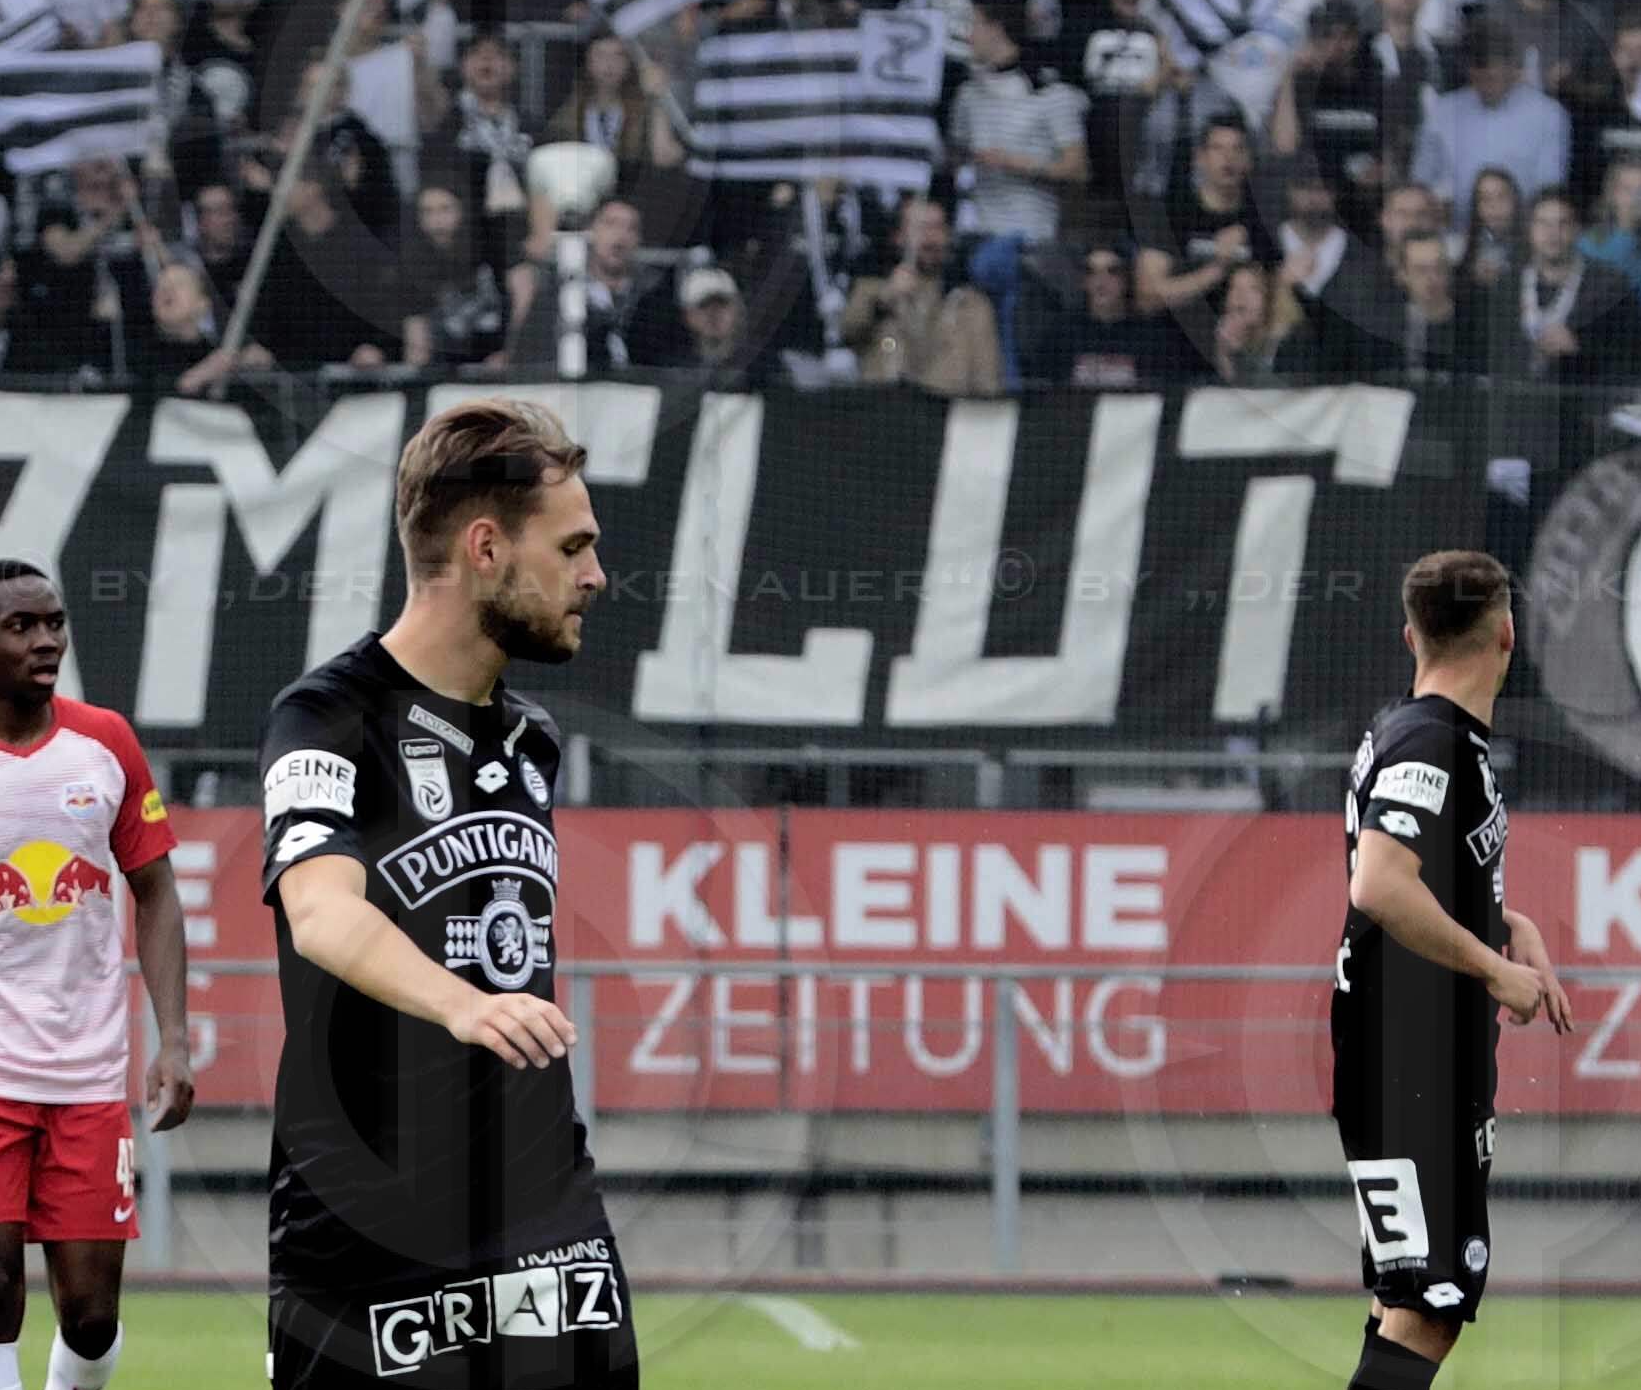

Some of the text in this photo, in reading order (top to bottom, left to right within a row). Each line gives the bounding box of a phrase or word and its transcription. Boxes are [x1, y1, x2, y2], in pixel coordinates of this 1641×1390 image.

[267, 758, 351, 791] LEINE
[398, 823, 557, 894] PUNTIGAM
[629, 841, 1169, 952] KLEINE
[629, 972, 1168, 1079] ZEITUNG
[380, 1271, 611, 1366] GRAZ
